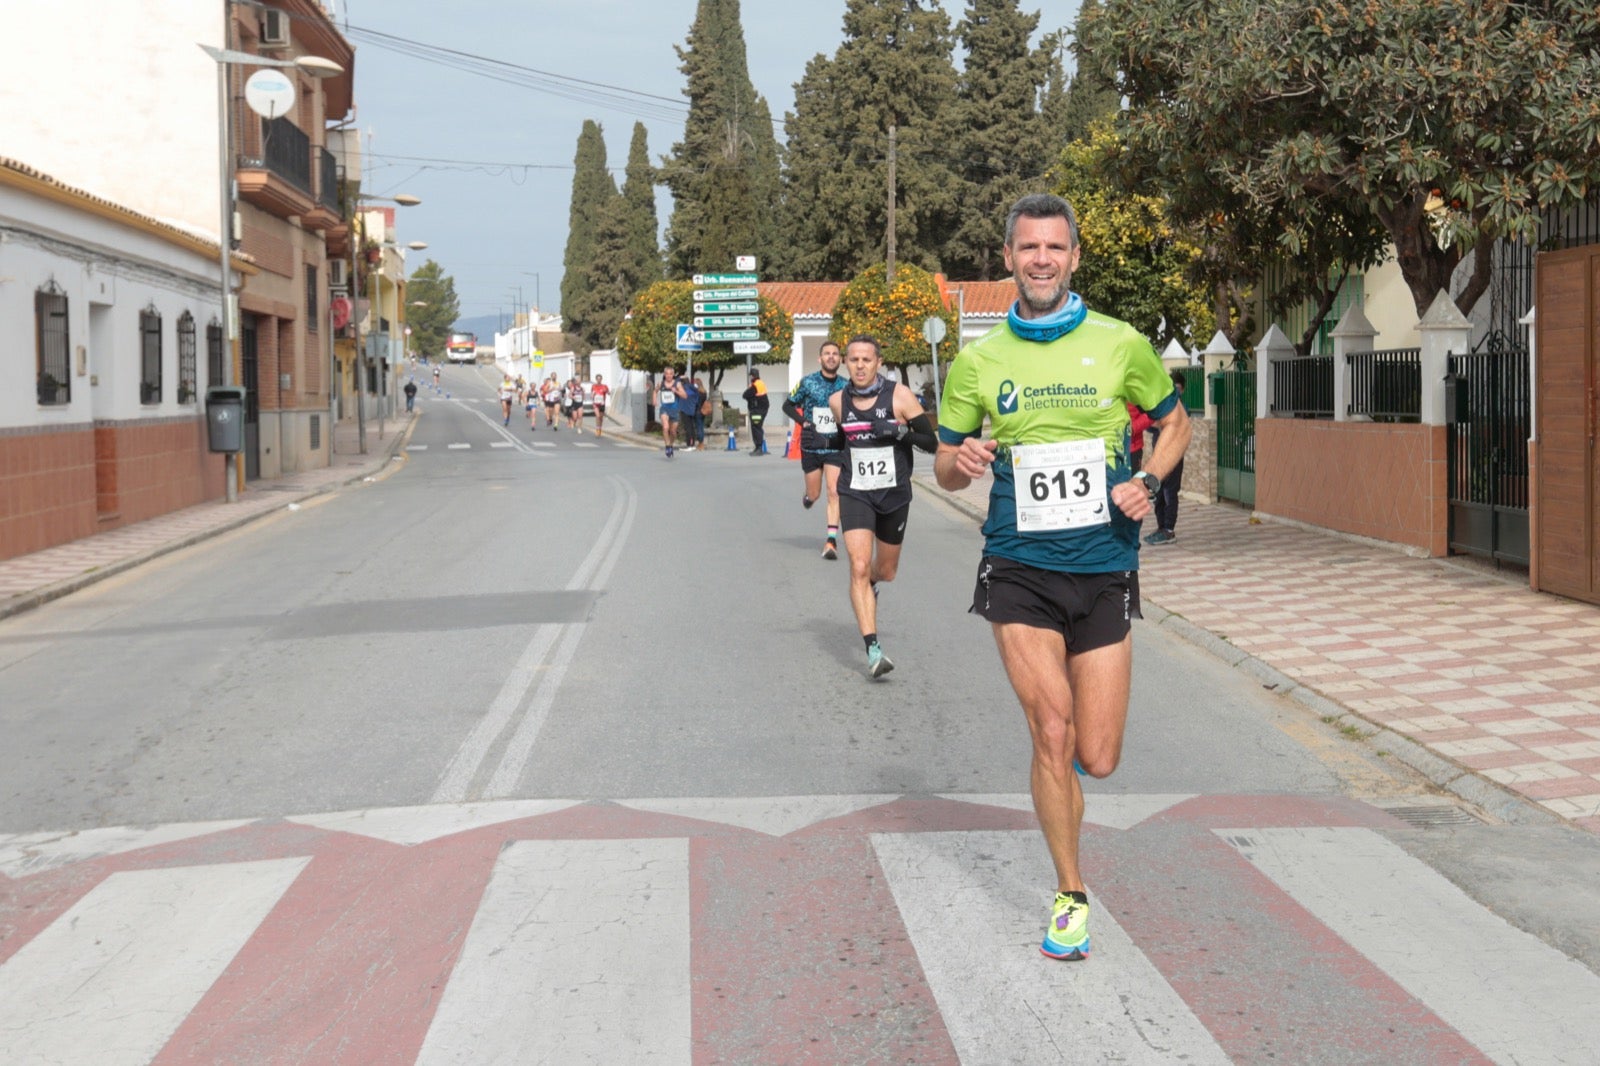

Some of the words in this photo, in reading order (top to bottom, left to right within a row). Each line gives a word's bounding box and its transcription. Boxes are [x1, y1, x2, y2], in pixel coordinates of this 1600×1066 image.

[1023, 383, 1097, 398] Certificado
[1024, 396, 1098, 411] electronico
[858, 460, 887, 476] 612
[1029, 467, 1091, 502] 613
